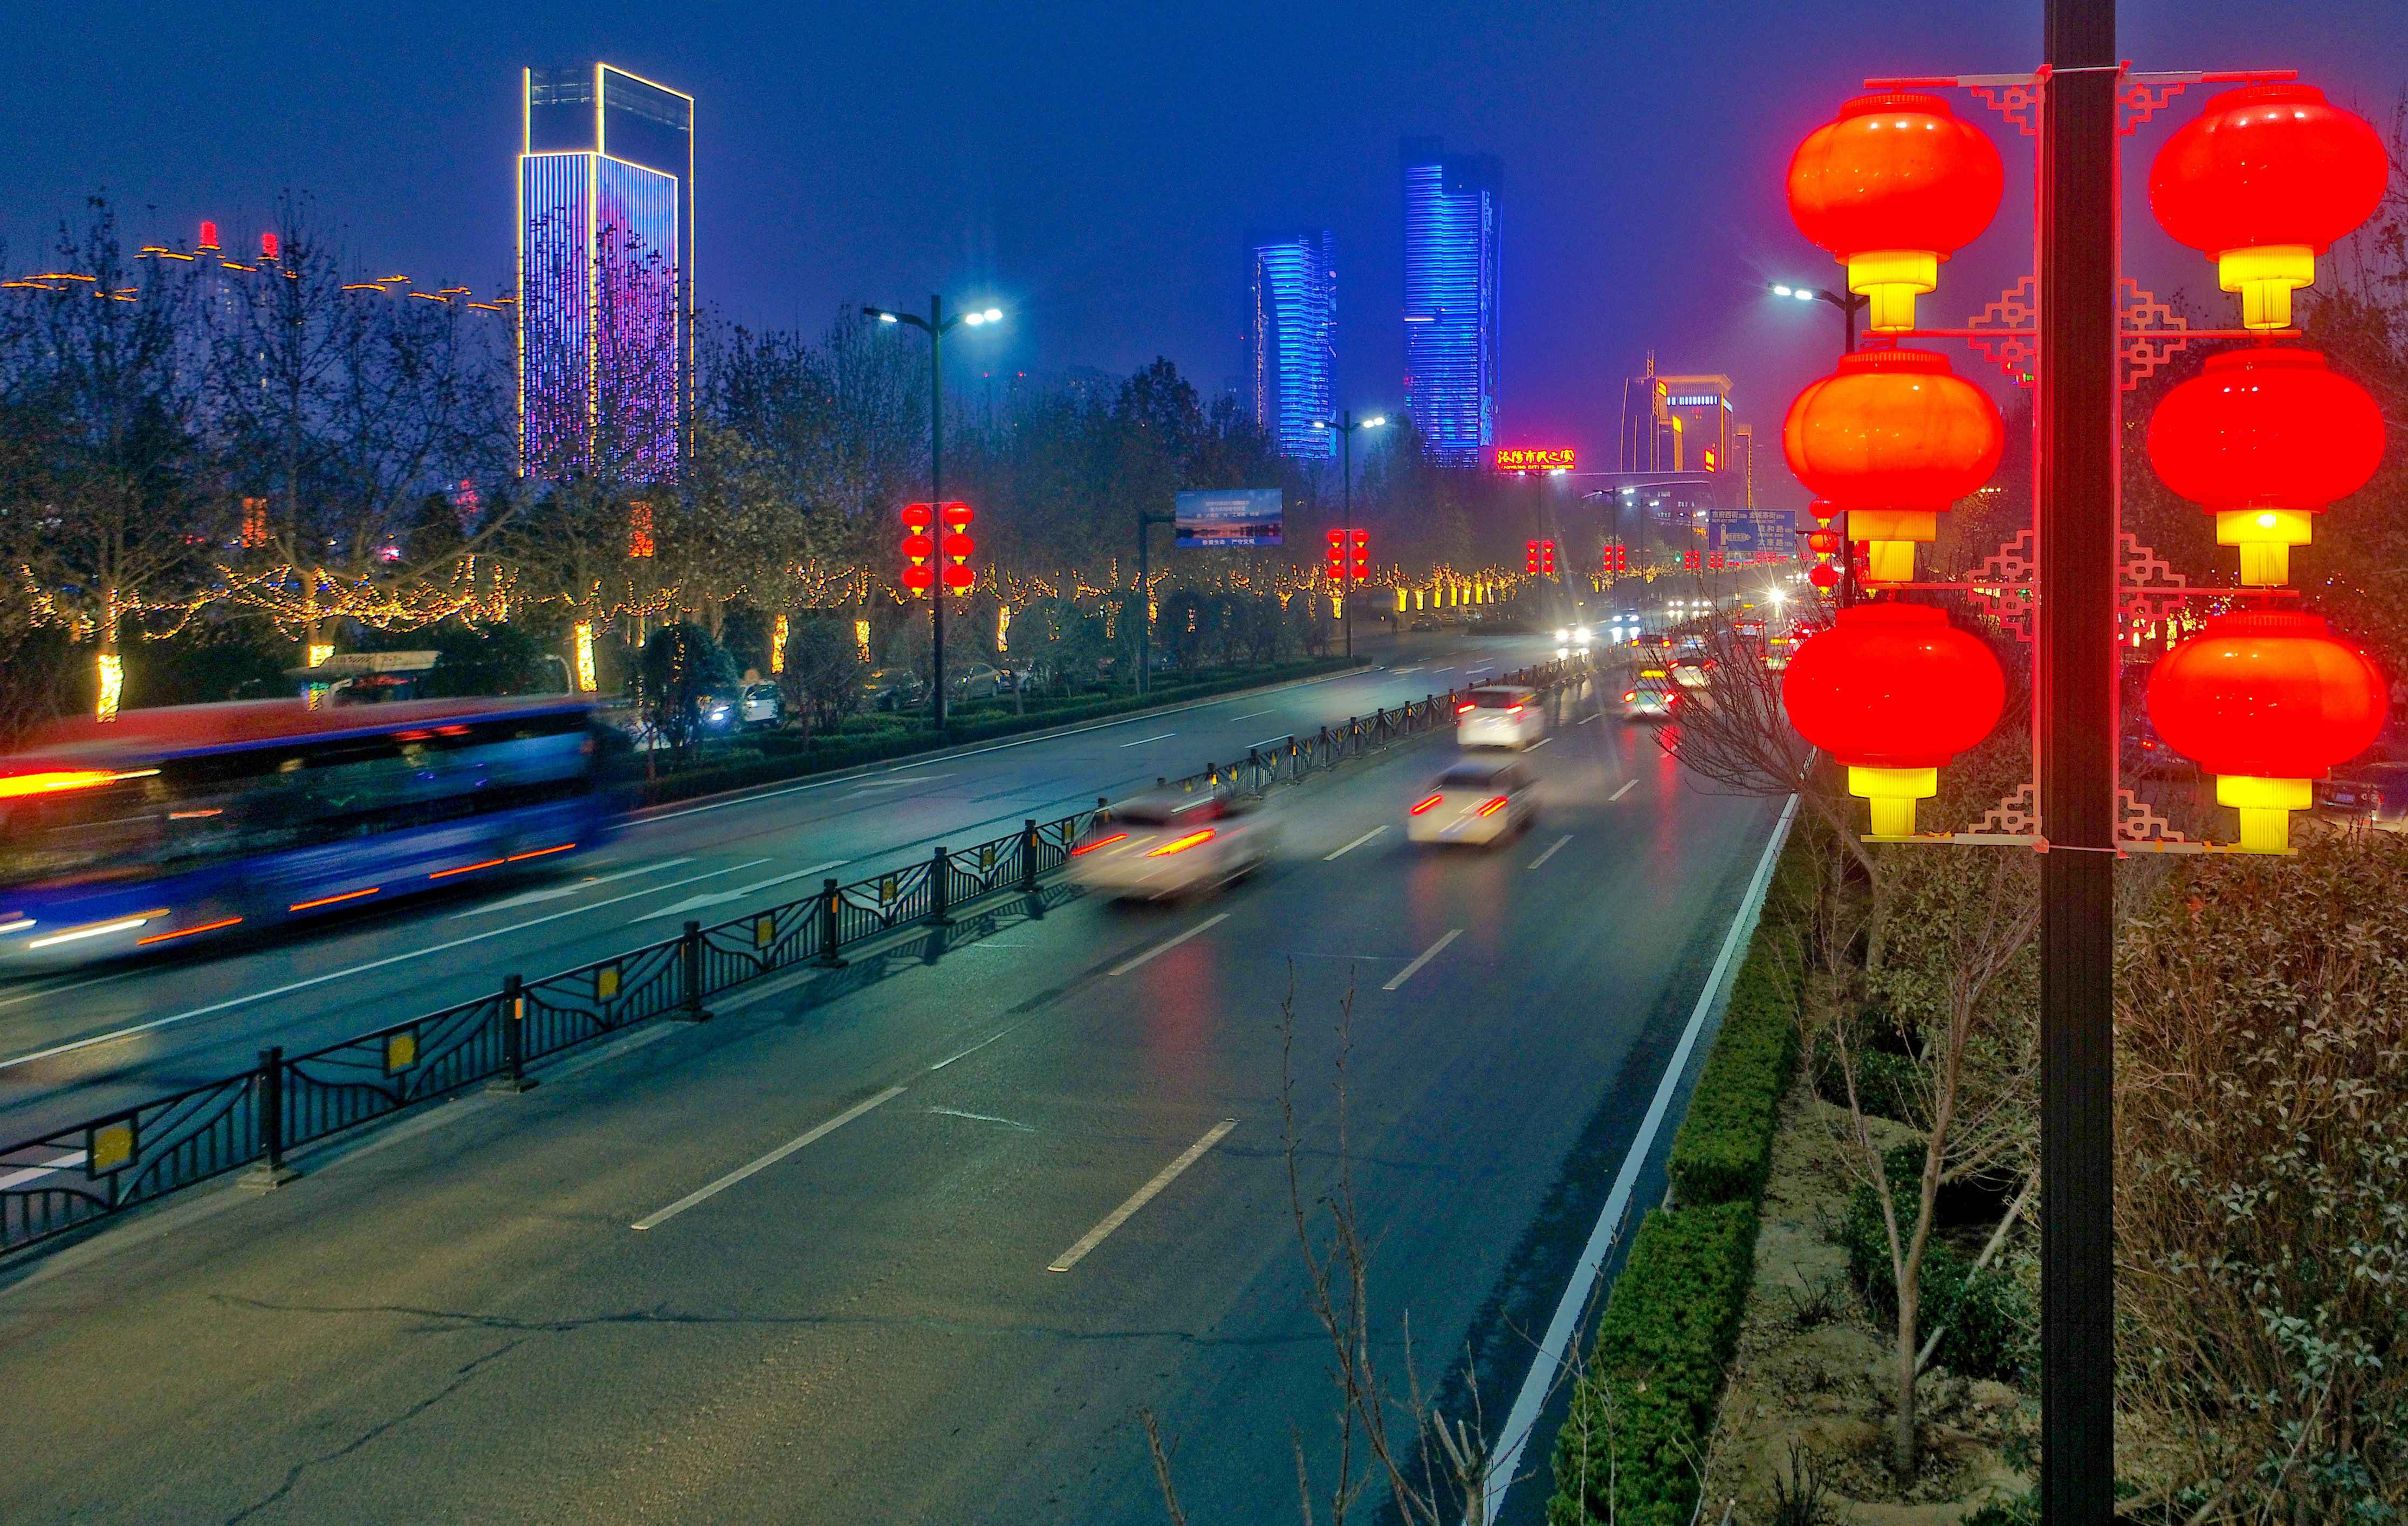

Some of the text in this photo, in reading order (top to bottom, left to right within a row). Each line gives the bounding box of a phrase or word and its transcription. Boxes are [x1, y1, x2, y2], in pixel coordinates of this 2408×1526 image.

[1498, 449, 1574, 464] 洛阳市民之家
